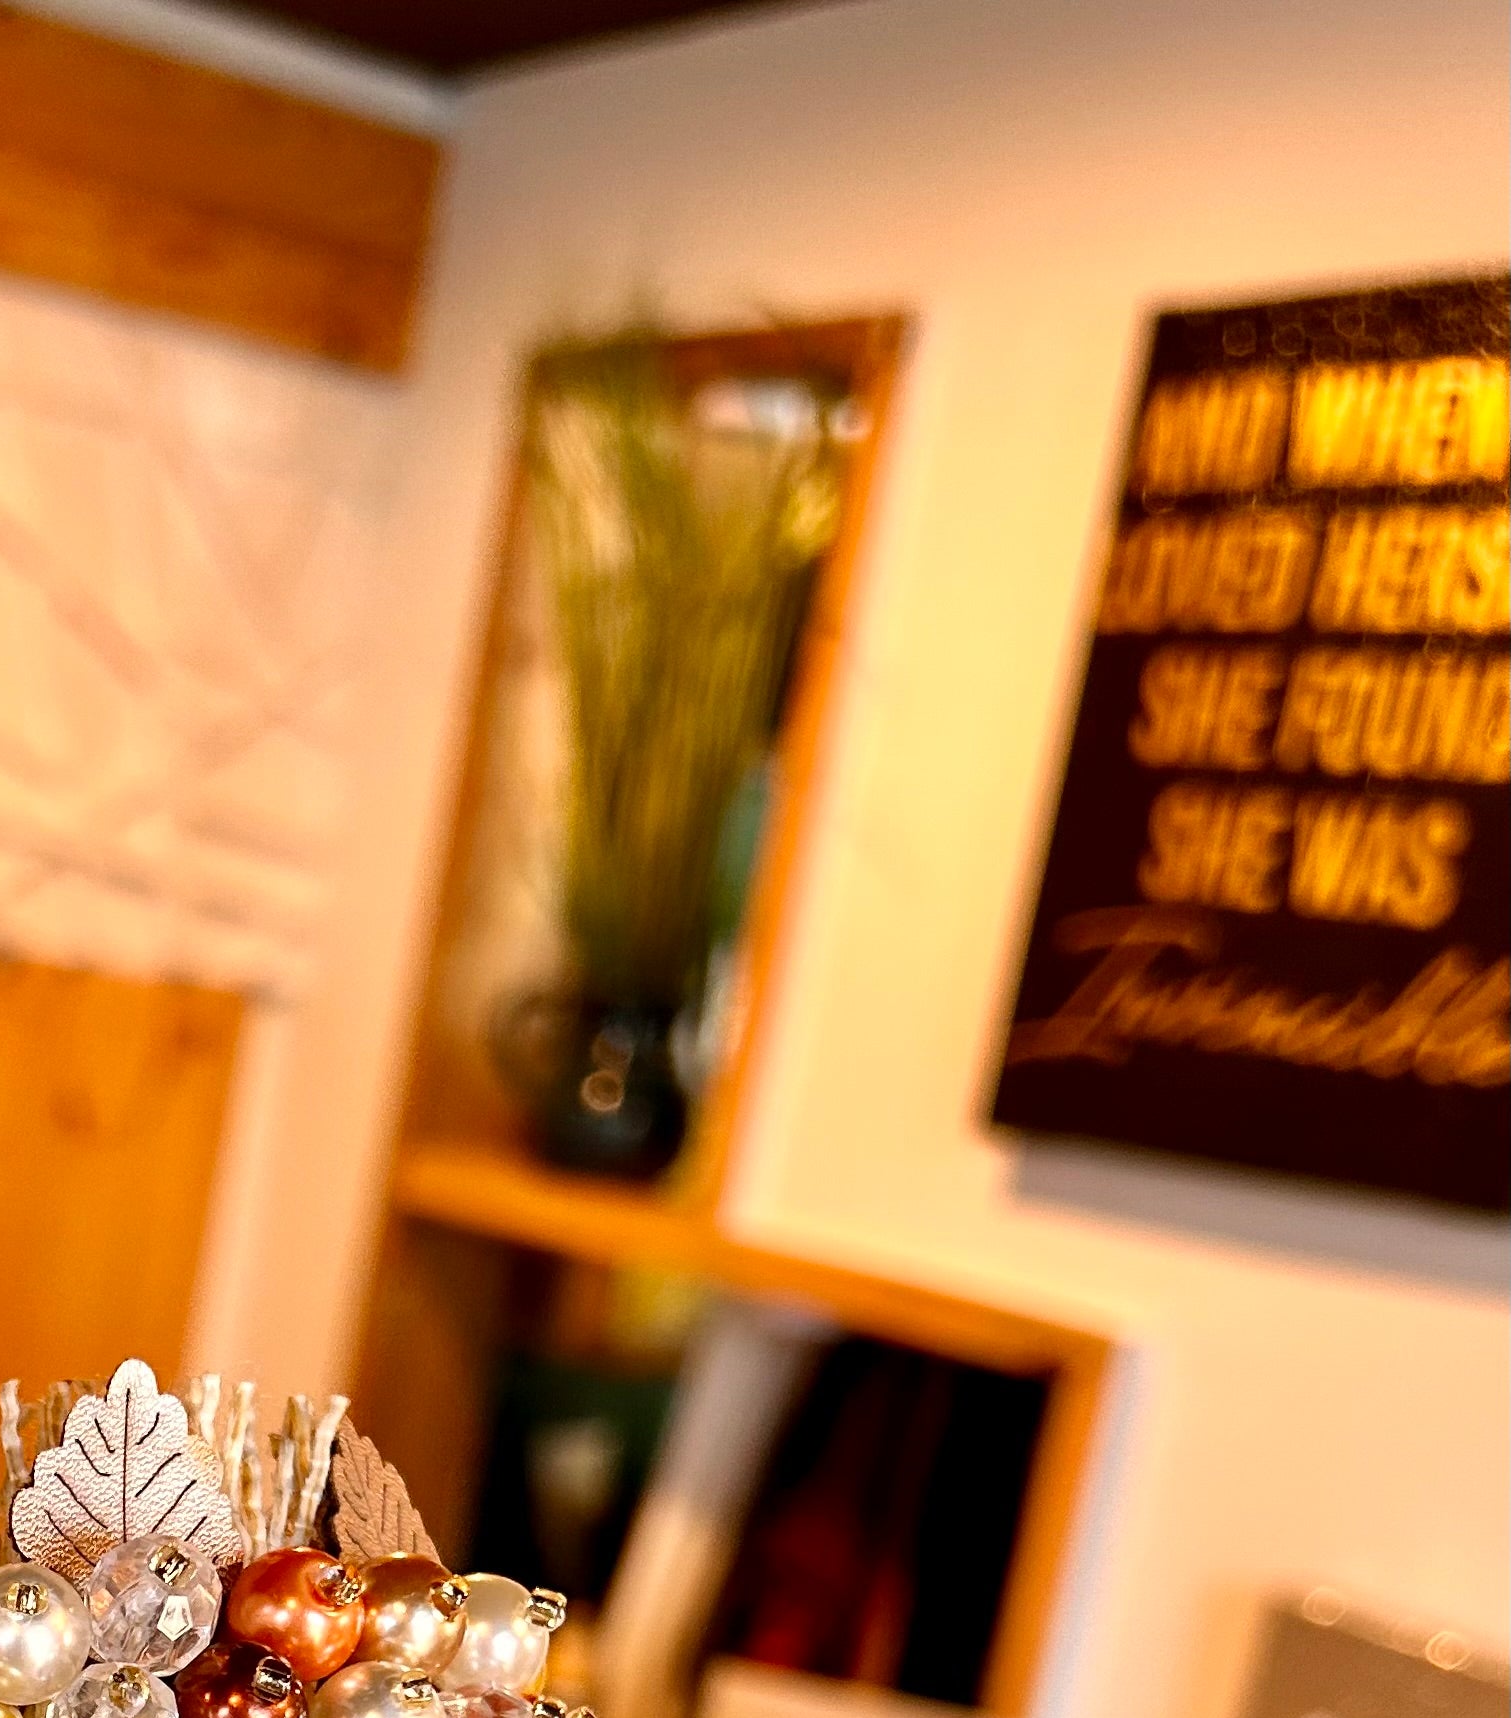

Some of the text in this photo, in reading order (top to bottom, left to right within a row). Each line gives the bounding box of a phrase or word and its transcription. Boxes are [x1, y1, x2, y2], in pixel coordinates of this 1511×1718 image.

[1128, 641, 1285, 771] SHE
[1137, 779, 1471, 931] SHE WAS
